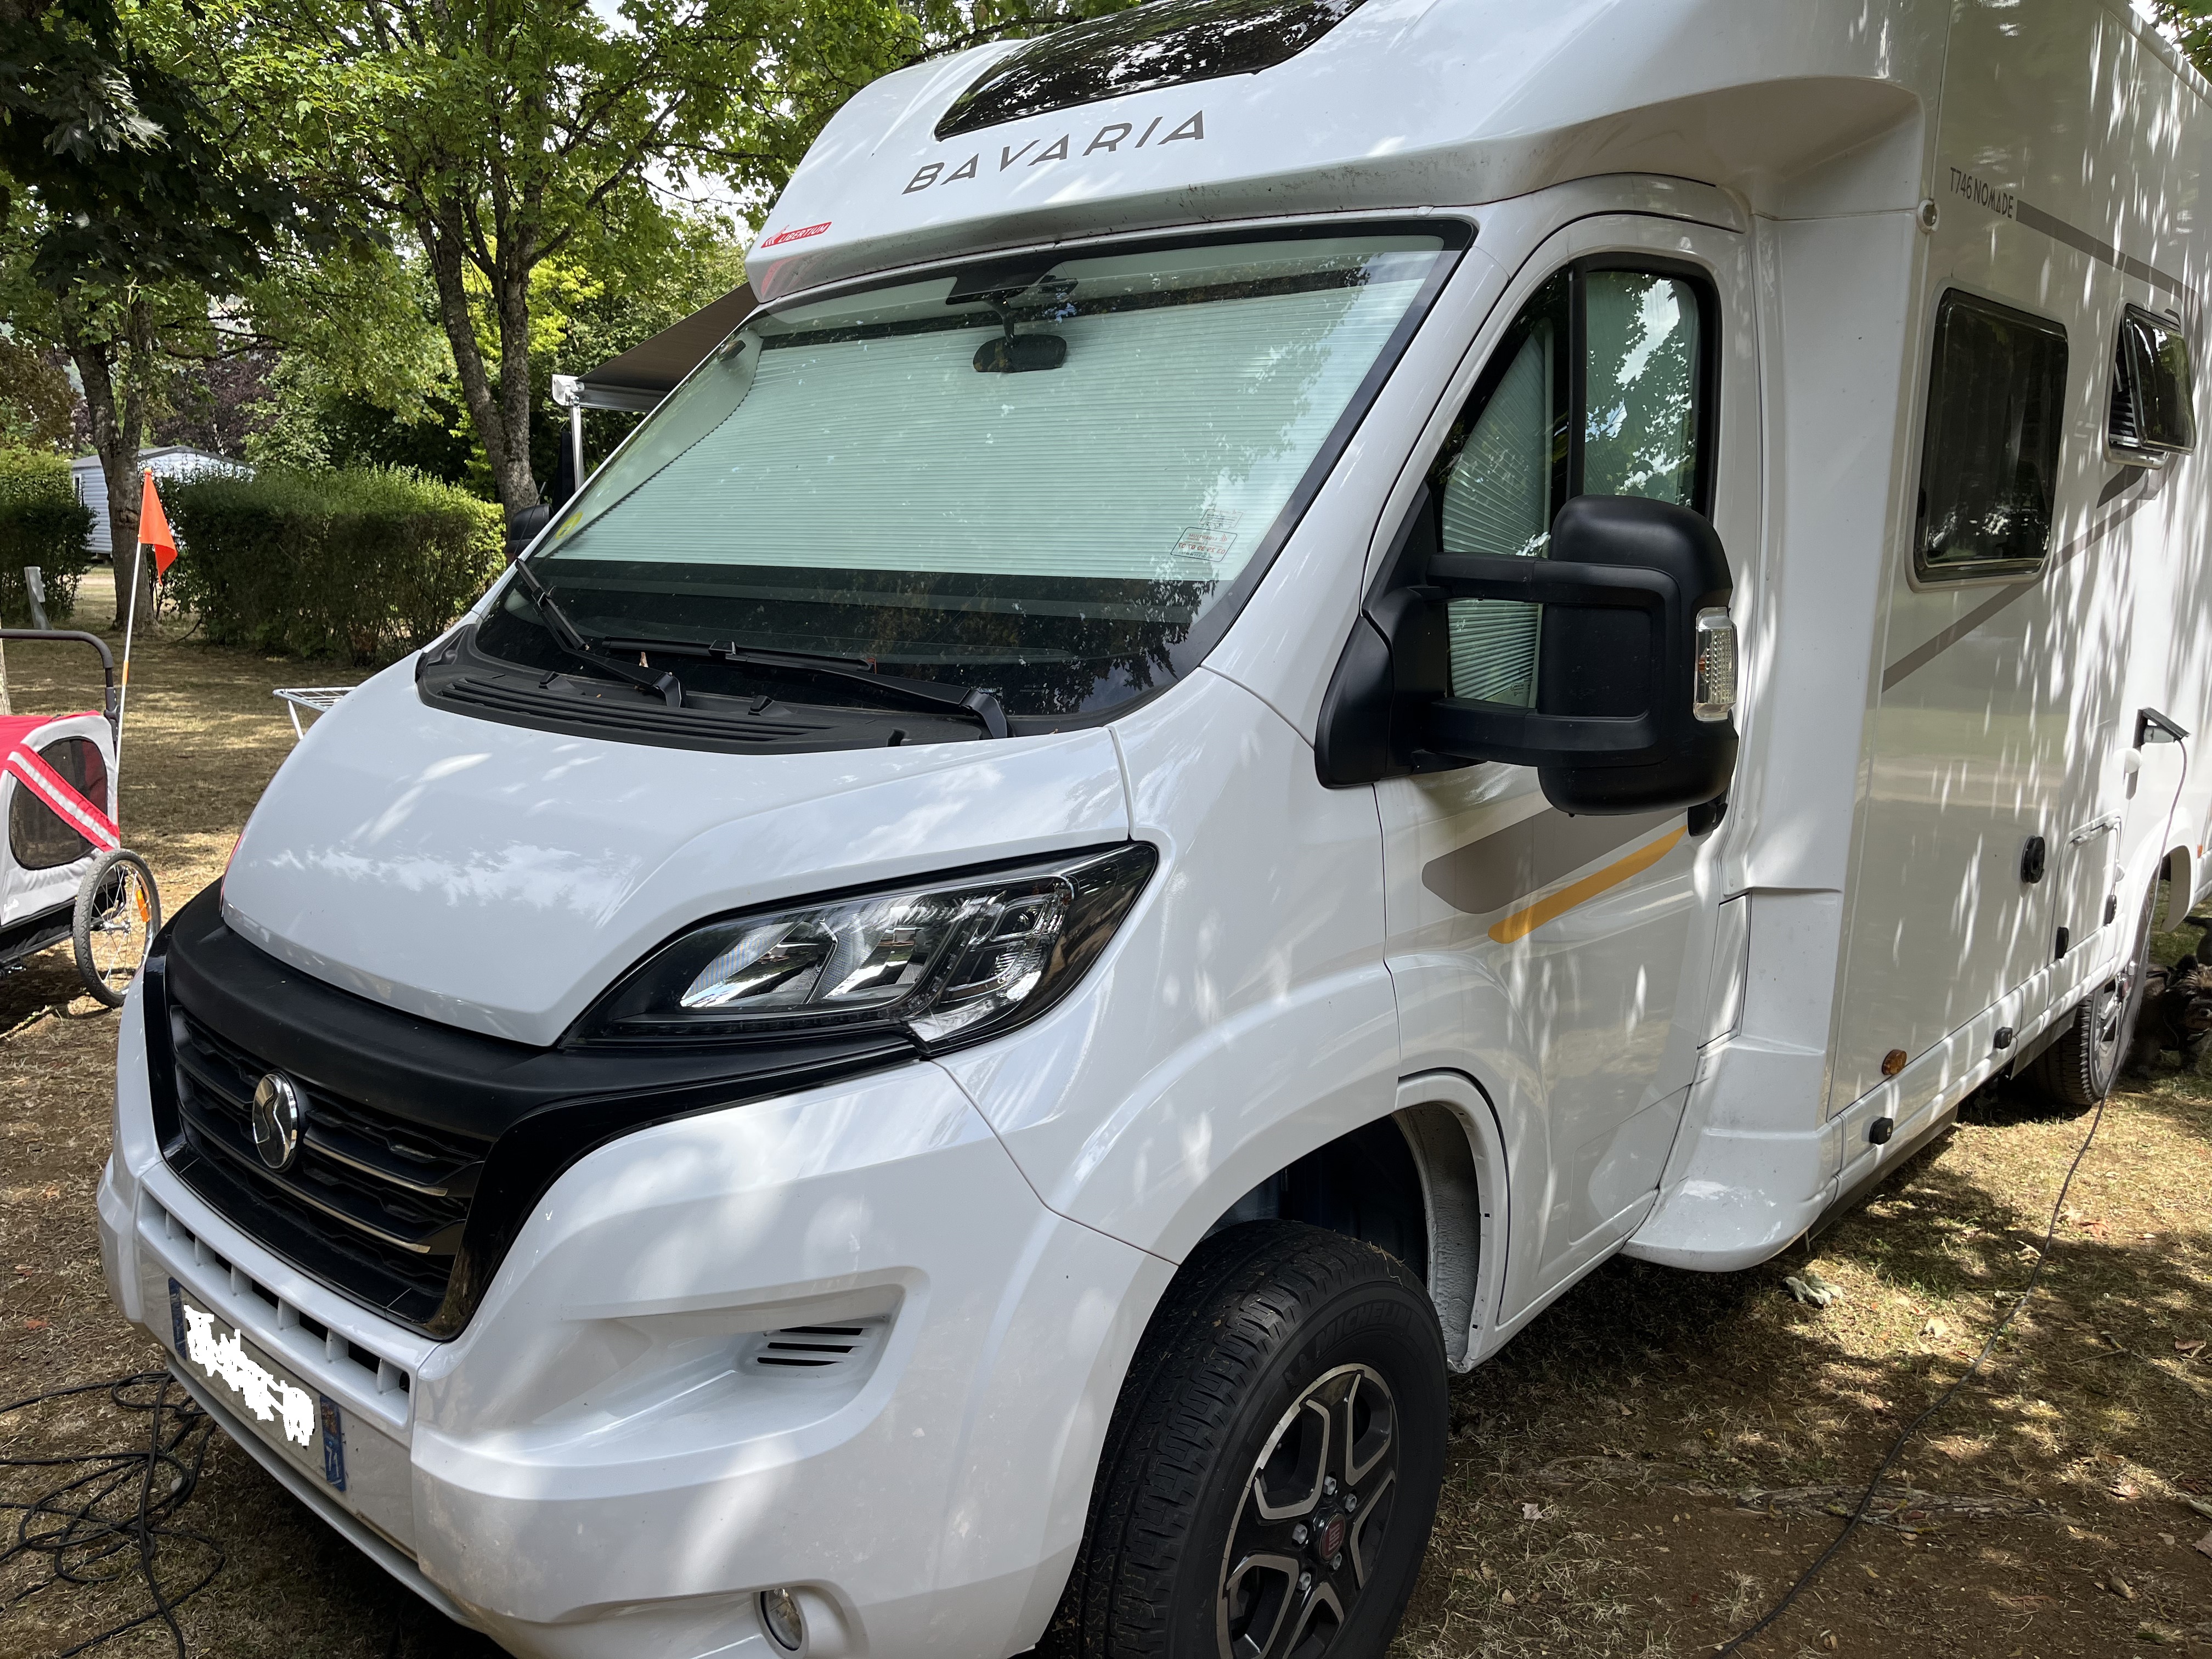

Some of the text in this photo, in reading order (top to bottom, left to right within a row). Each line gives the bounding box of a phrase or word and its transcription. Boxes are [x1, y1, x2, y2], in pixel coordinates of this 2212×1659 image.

[901, 110, 1206, 195] BAVARIA
[1950, 167, 2014, 219] T746 NOMADE
[778, 224, 829, 243] LIBERTIUM
[1316, 1302, 1411, 1358] MICHELIN
